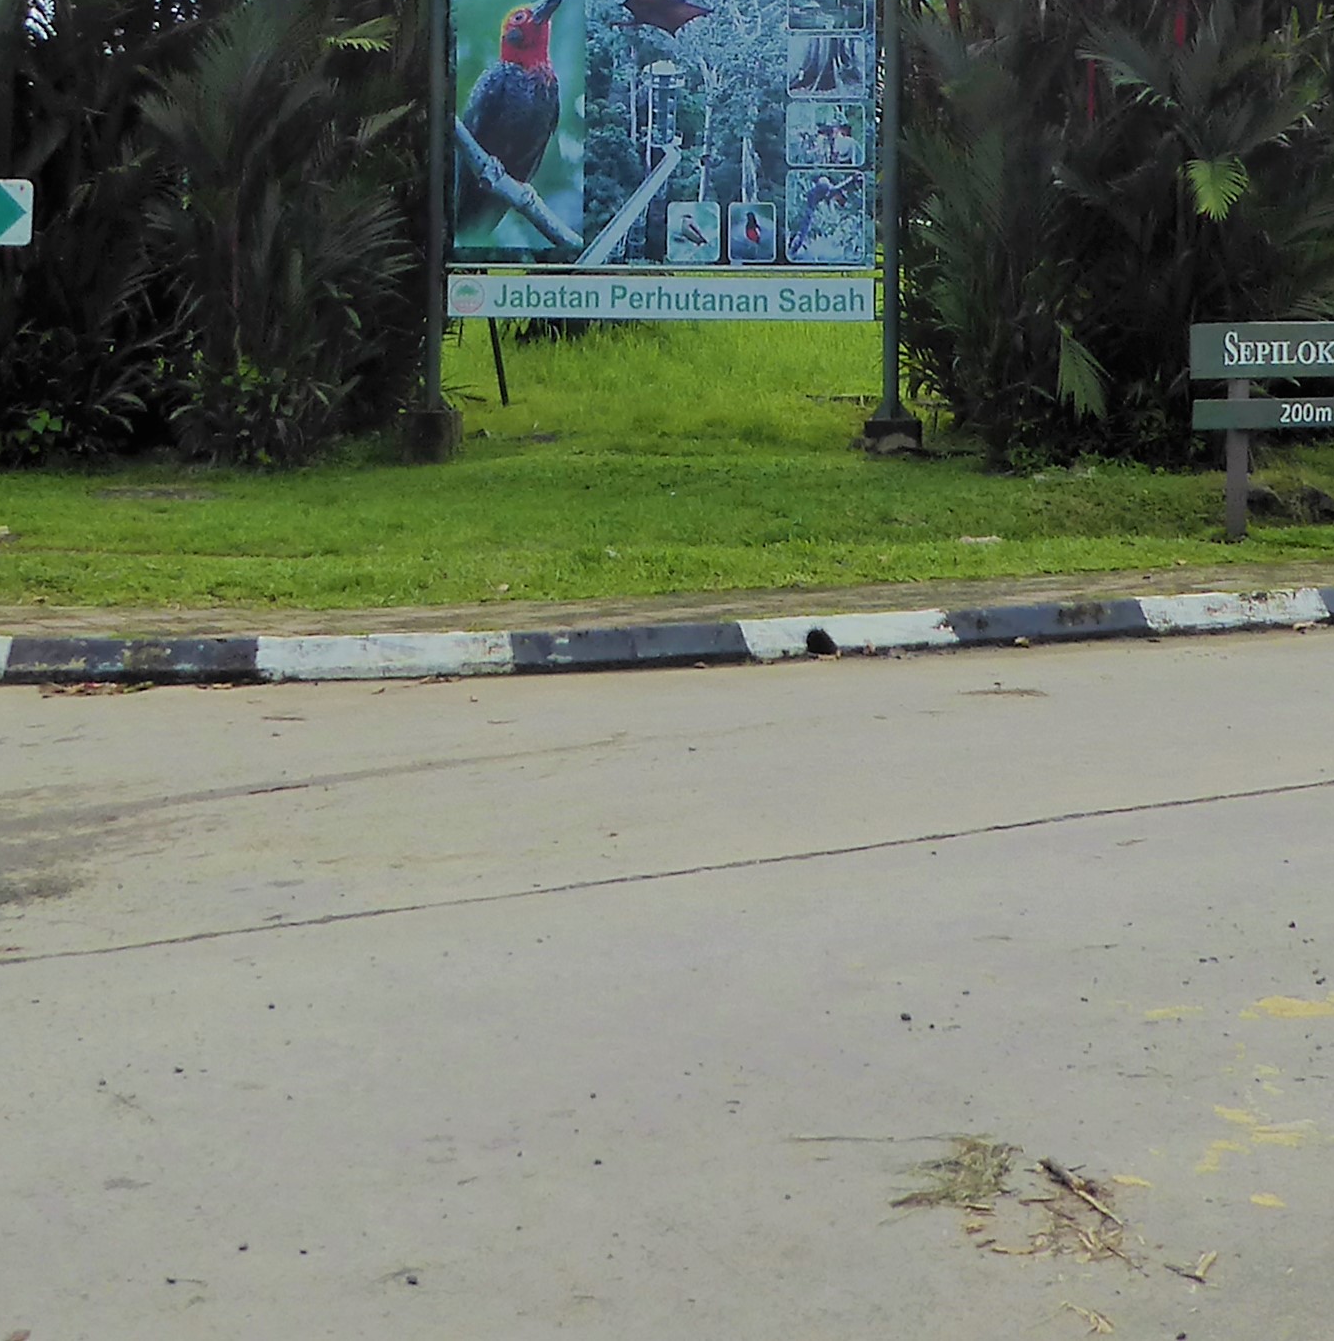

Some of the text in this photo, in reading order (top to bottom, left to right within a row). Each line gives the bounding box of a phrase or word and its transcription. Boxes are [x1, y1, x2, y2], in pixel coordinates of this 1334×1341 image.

[493, 284, 865, 313] Jabatan Perhutanan Sabah
[1279, 403, 1332, 423] 200m
